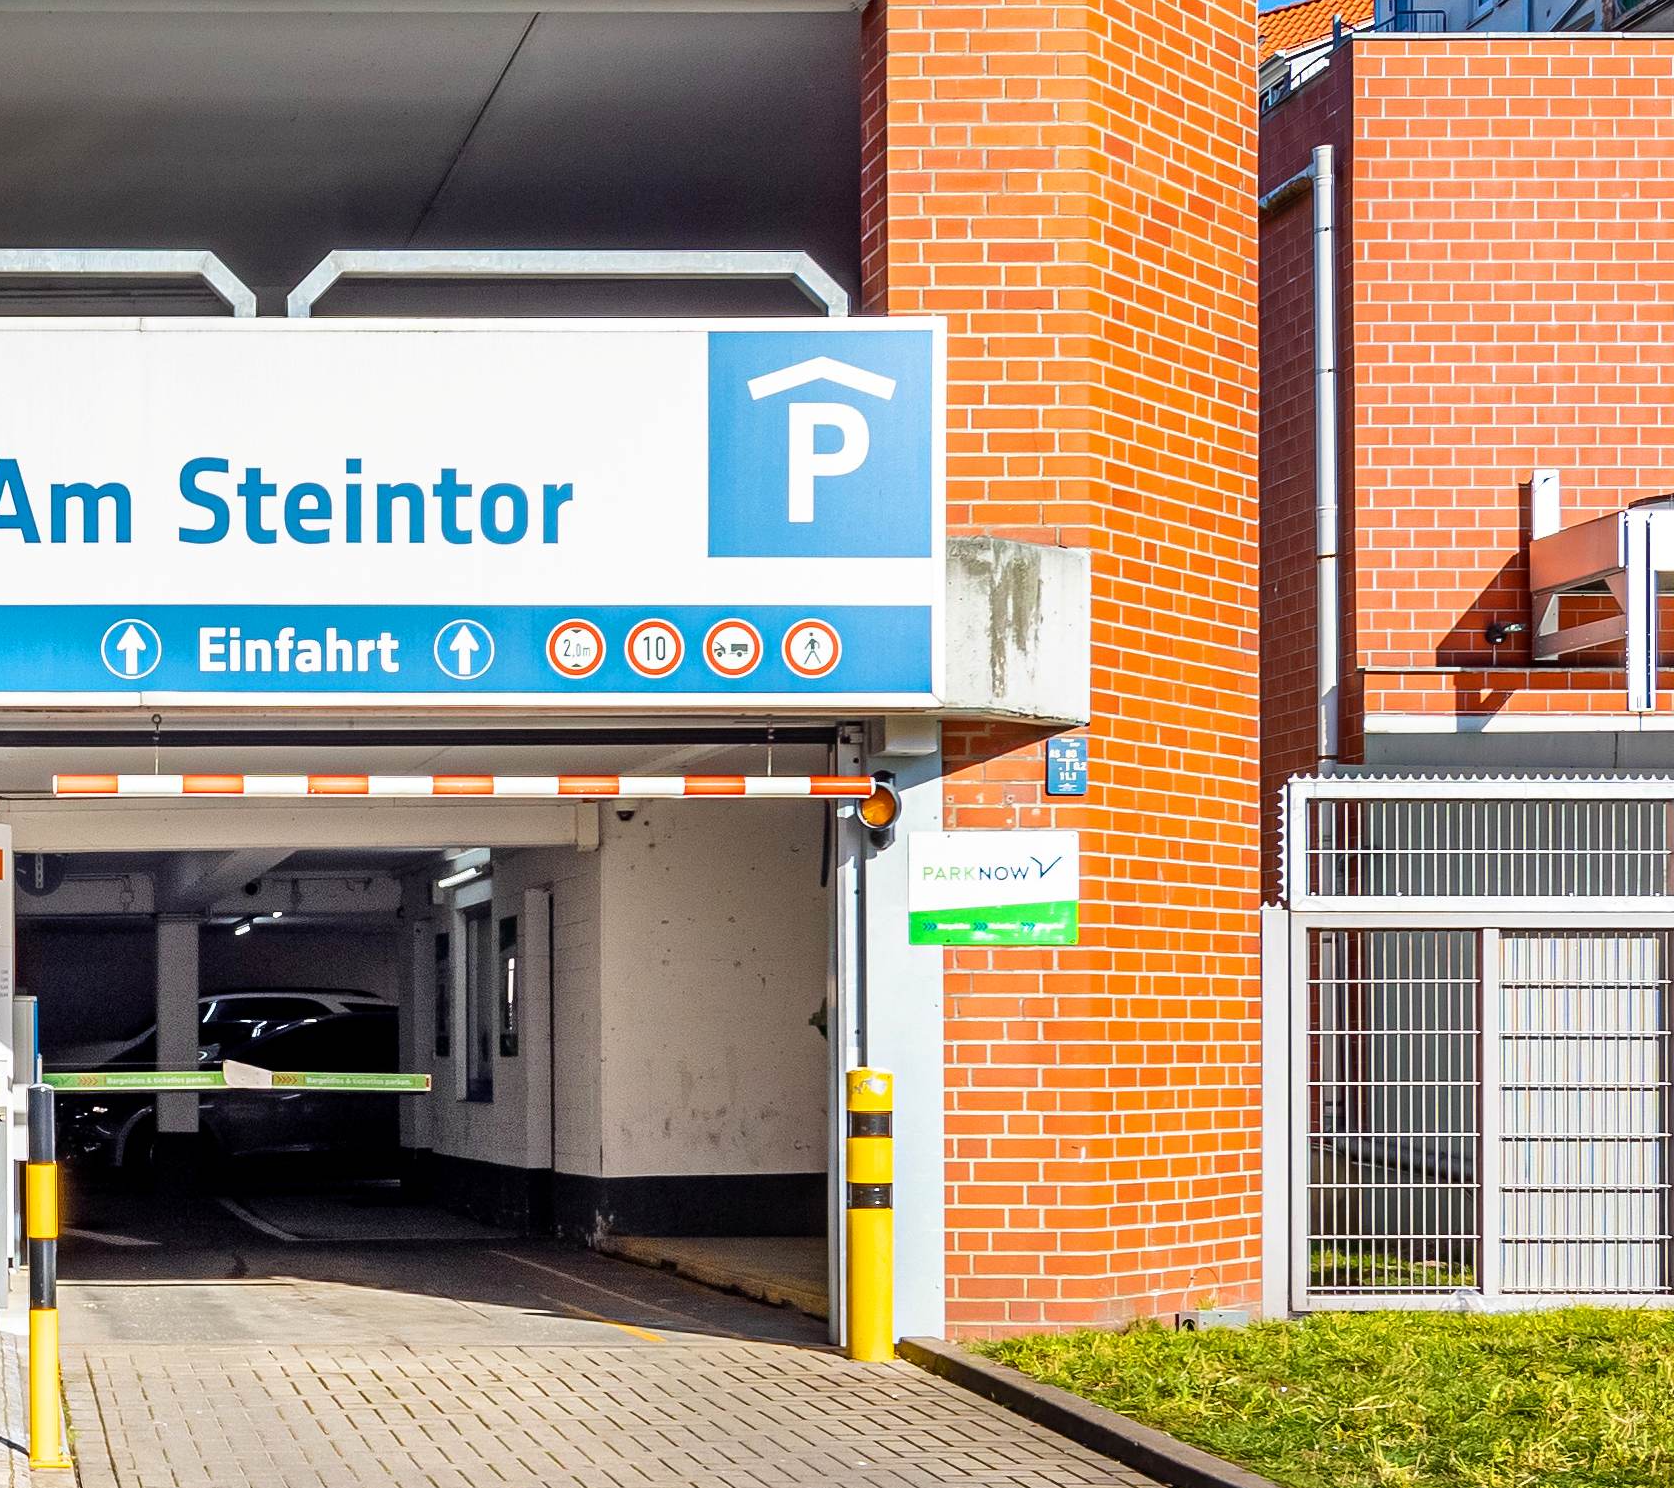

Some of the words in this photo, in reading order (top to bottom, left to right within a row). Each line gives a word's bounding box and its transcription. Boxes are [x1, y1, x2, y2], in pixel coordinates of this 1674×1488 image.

[177, 456, 574, 545] Steintor
[199, 626, 400, 673] Einfahrt
[643, 636, 666, 661] 10
